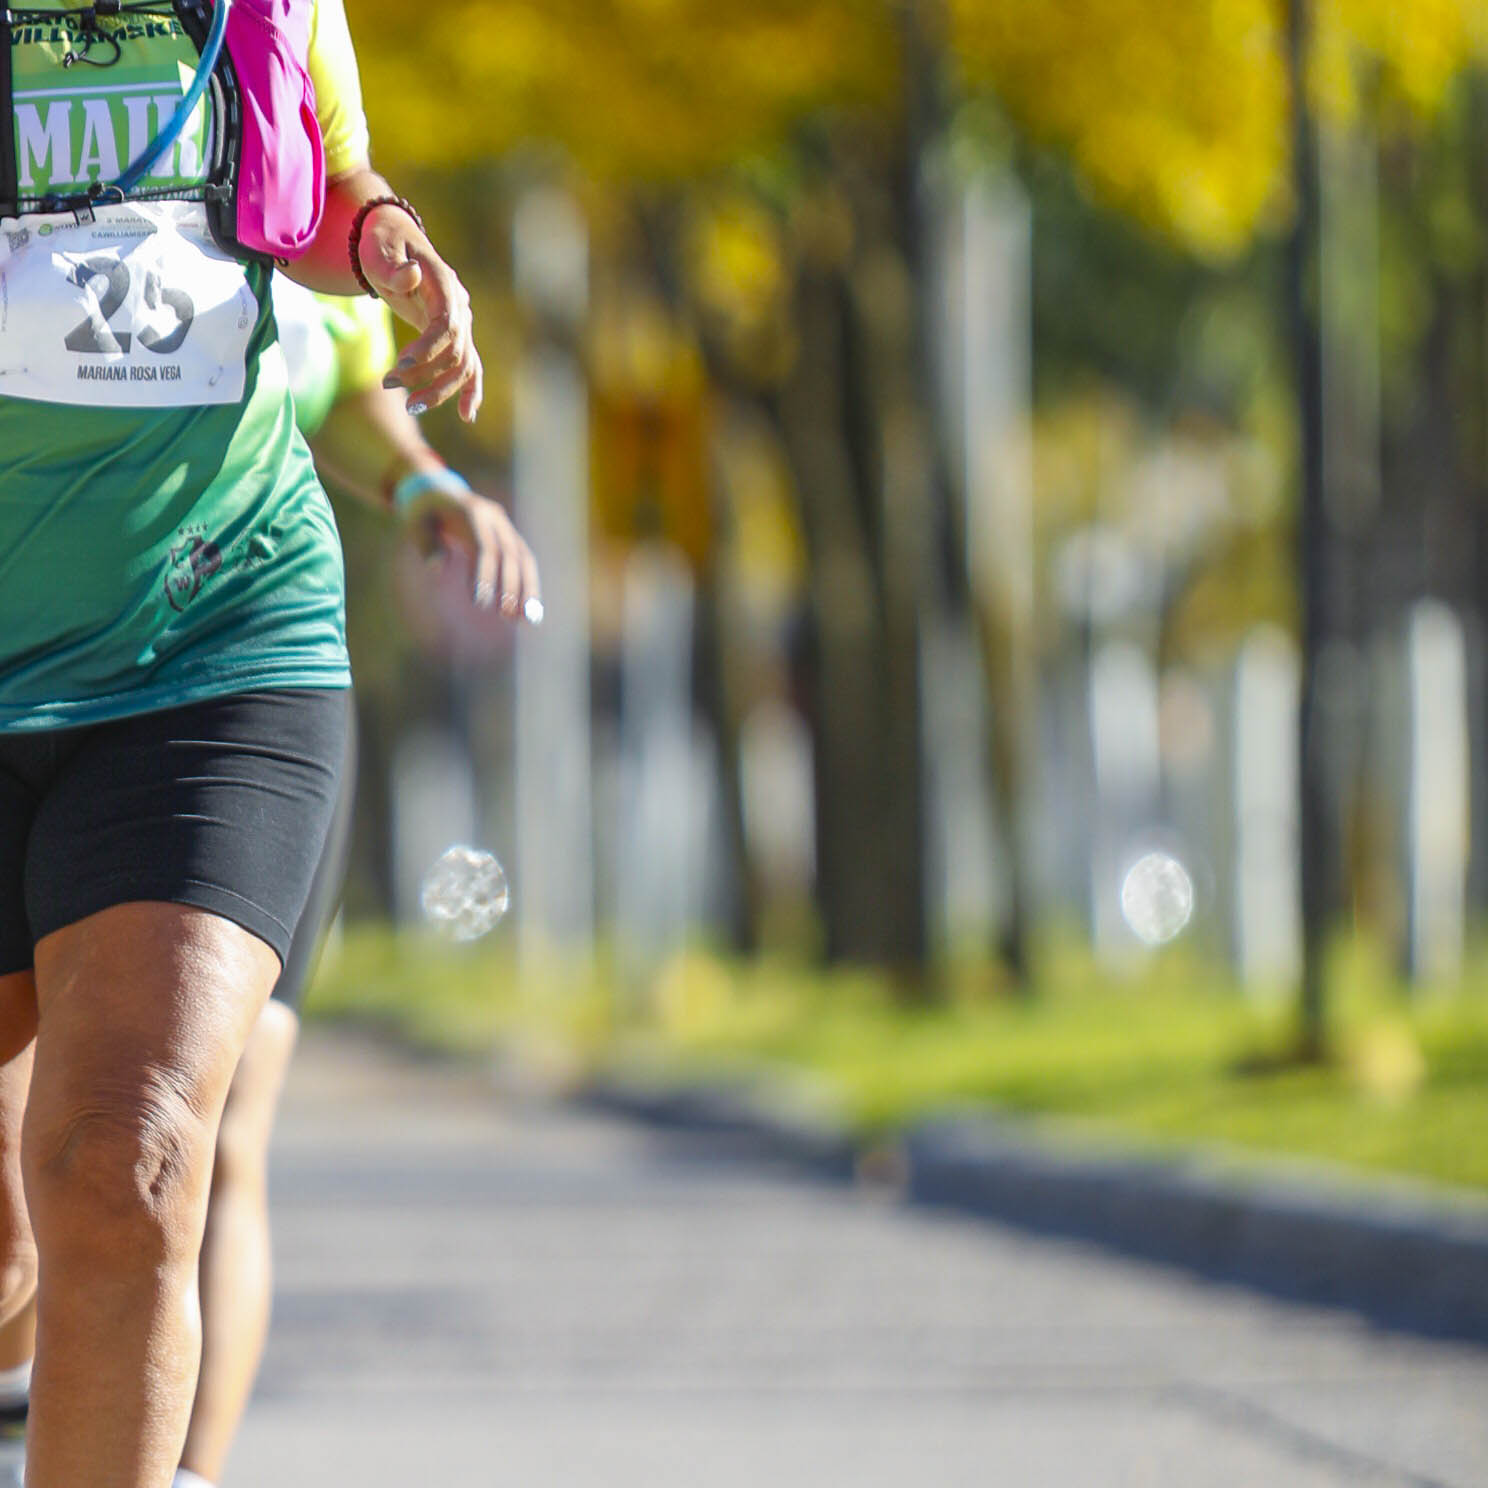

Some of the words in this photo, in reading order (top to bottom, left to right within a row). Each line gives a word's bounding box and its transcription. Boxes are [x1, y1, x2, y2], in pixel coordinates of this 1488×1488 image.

[77, 365, 127, 381] MARIANA
[129, 366, 157, 381] ROSA
[159, 365, 182, 381] VEGA
